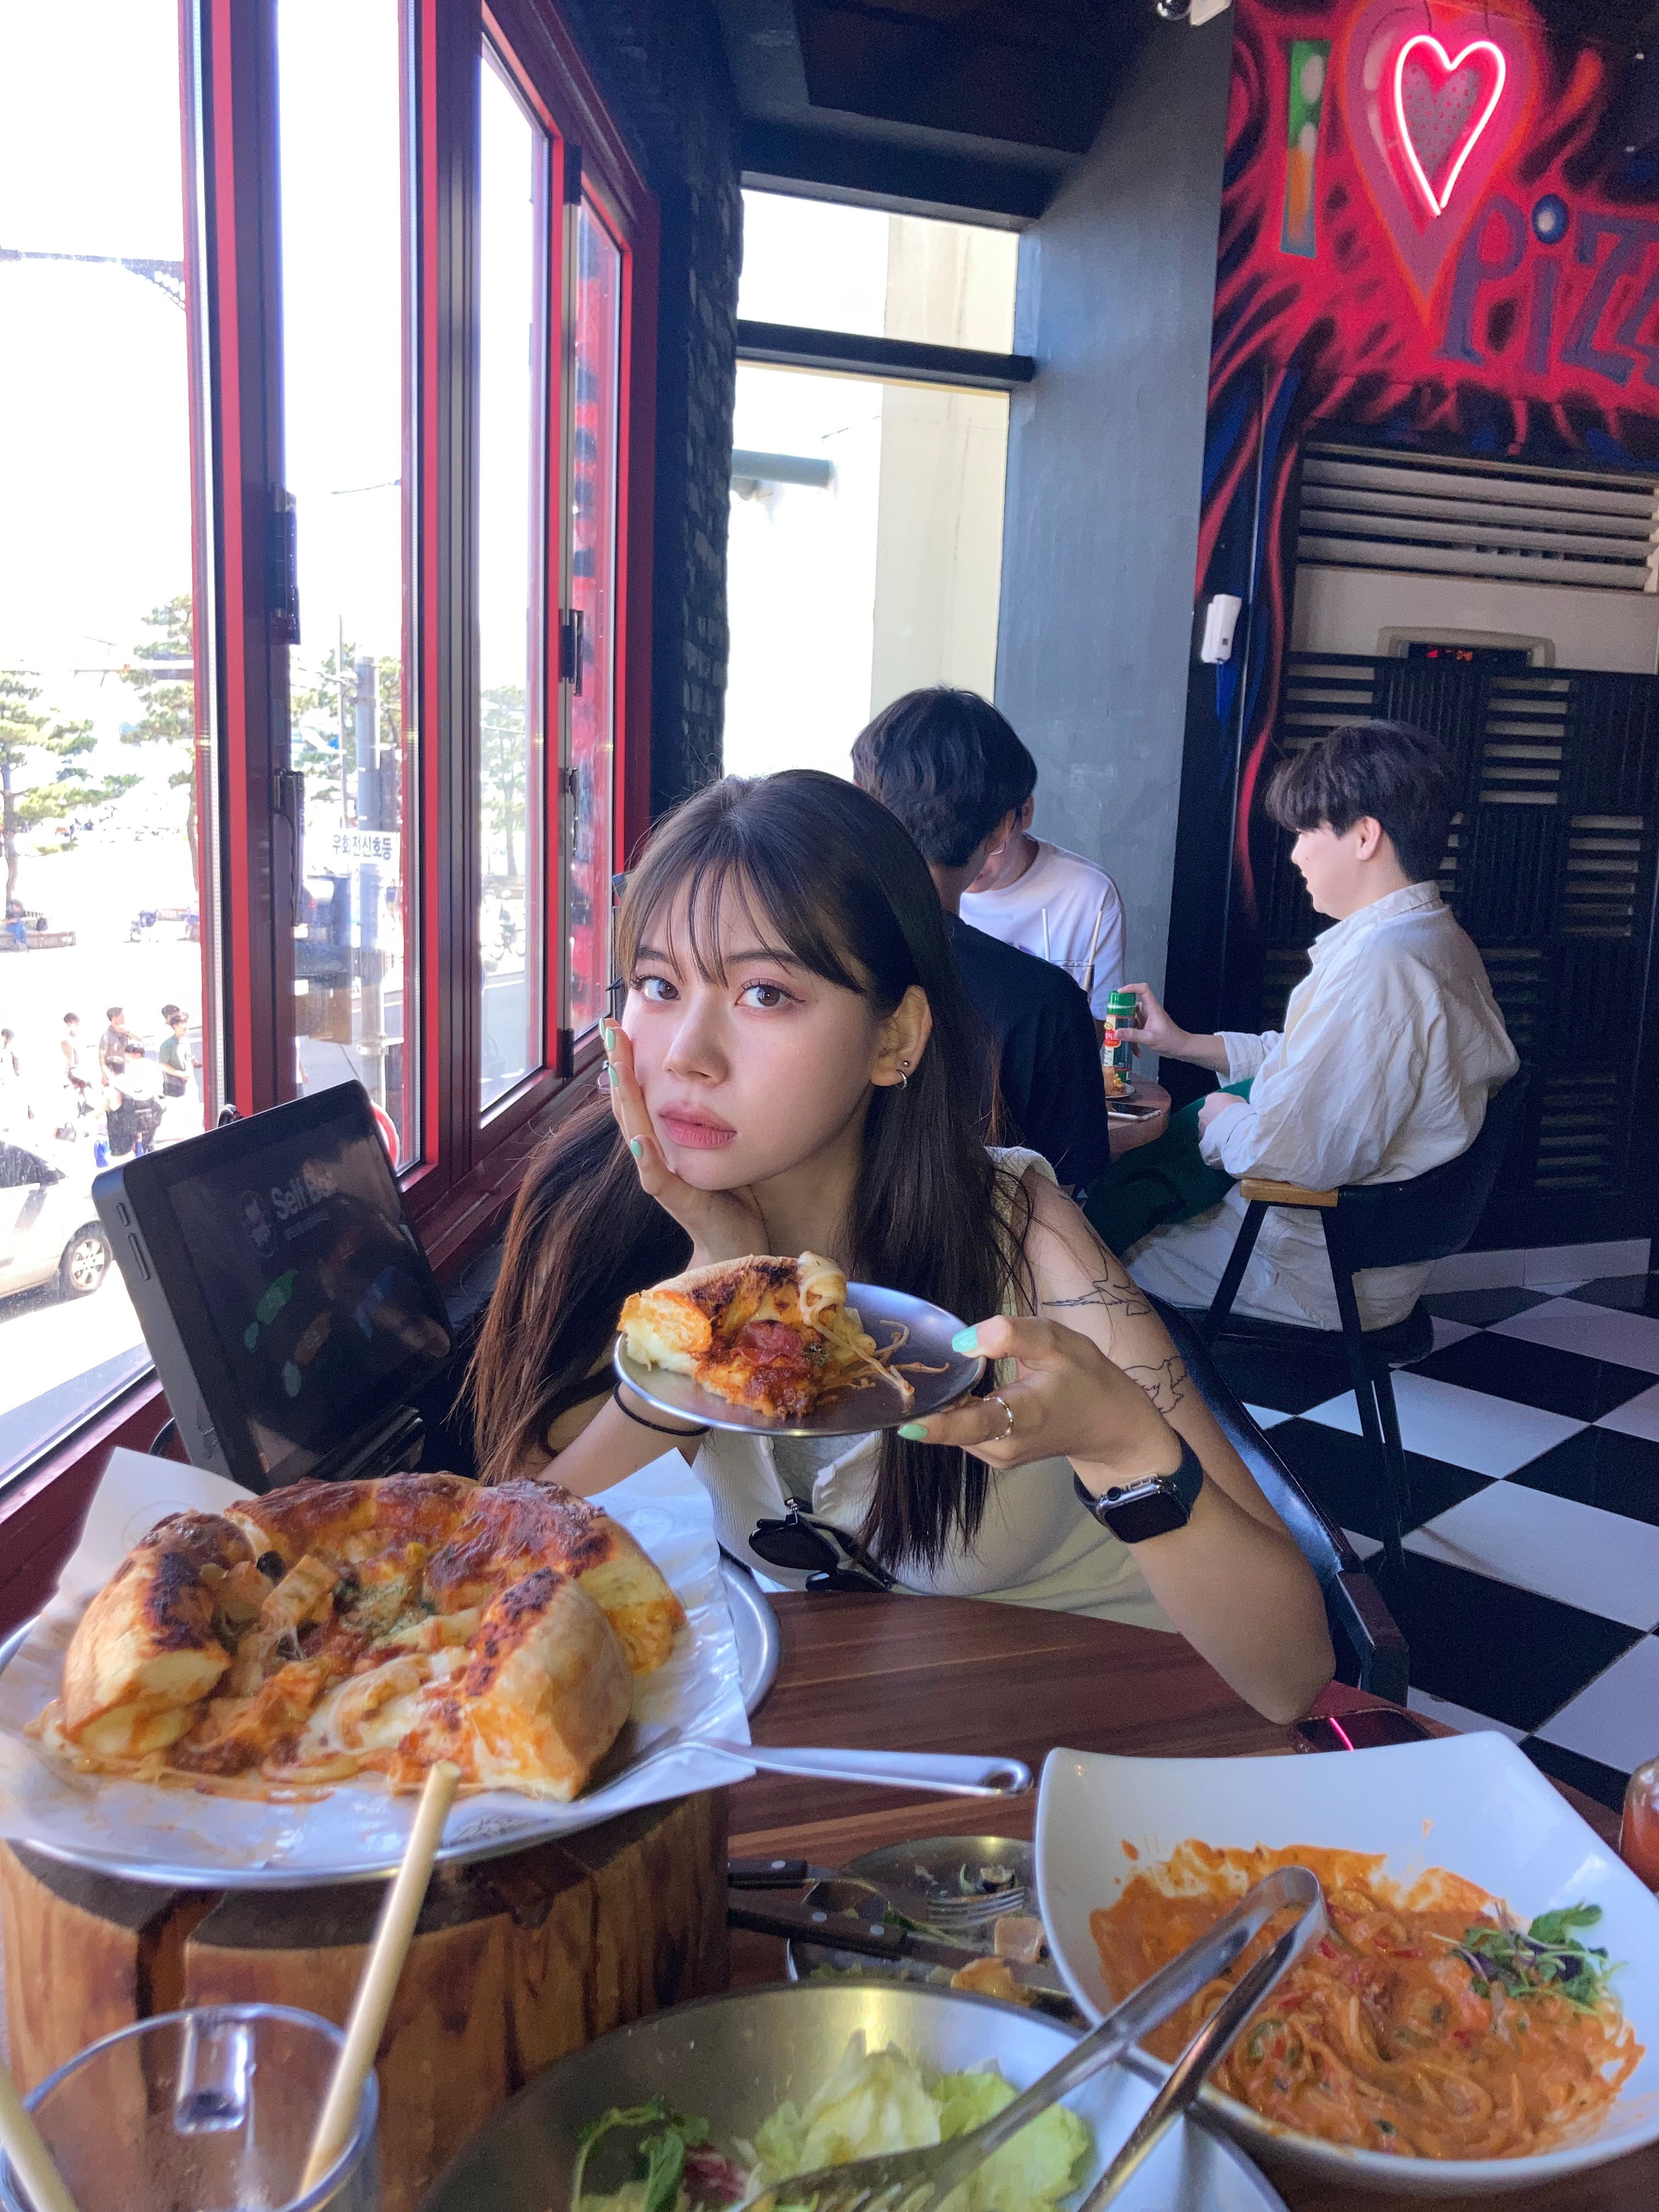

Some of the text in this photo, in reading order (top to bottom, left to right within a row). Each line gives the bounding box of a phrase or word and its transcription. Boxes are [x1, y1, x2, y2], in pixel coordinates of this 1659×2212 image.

[1280, 40, 1331, 259] I
[332, 834, 393, 860] 우회전신호등
[271, 1176, 308, 1220] Self
